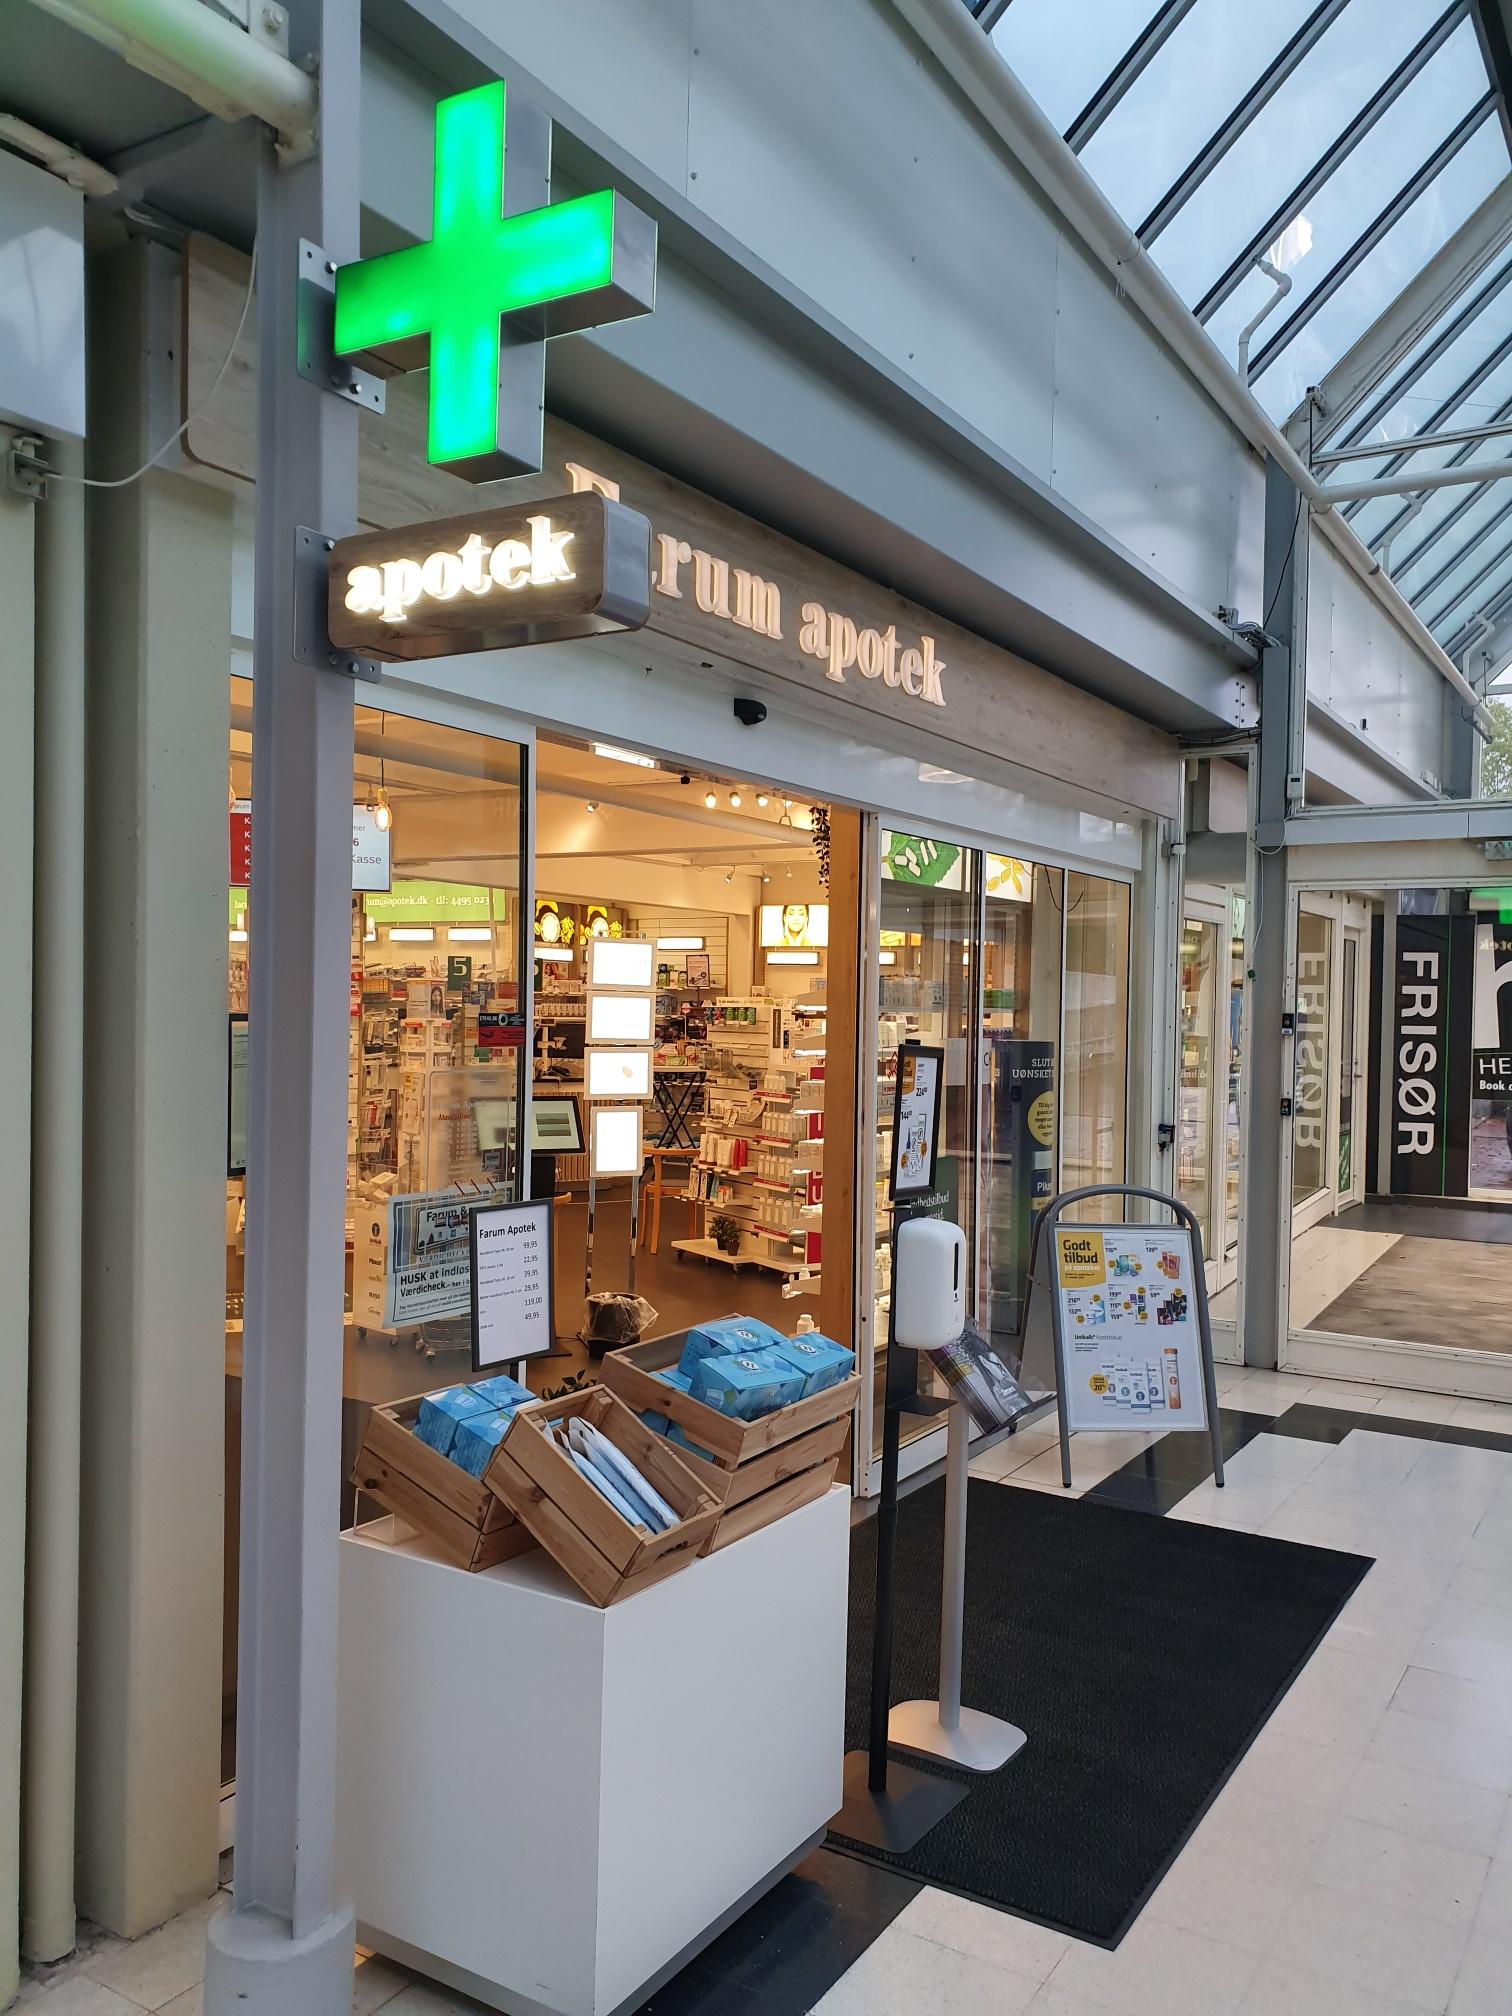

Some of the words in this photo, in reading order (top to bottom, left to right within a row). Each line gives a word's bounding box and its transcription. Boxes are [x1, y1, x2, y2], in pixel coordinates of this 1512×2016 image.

[344, 515, 576, 622] apotek
[565, 462, 784, 641] rum
[799, 602, 946, 706] apotek
[453, 957, 468, 976] 5
[1398, 952, 1440, 1155] FRISØR
[1480, 1080, 1505, 1091] Book
[480, 1228, 505, 1239] Farum
[508, 1221, 536, 1236] Apotek
[1063, 1240, 1092, 1251] Godt
[1064, 1252, 1098, 1263] tilbud
[400, 1271, 427, 1286] HUSK
[429, 1269, 439, 1280] at
